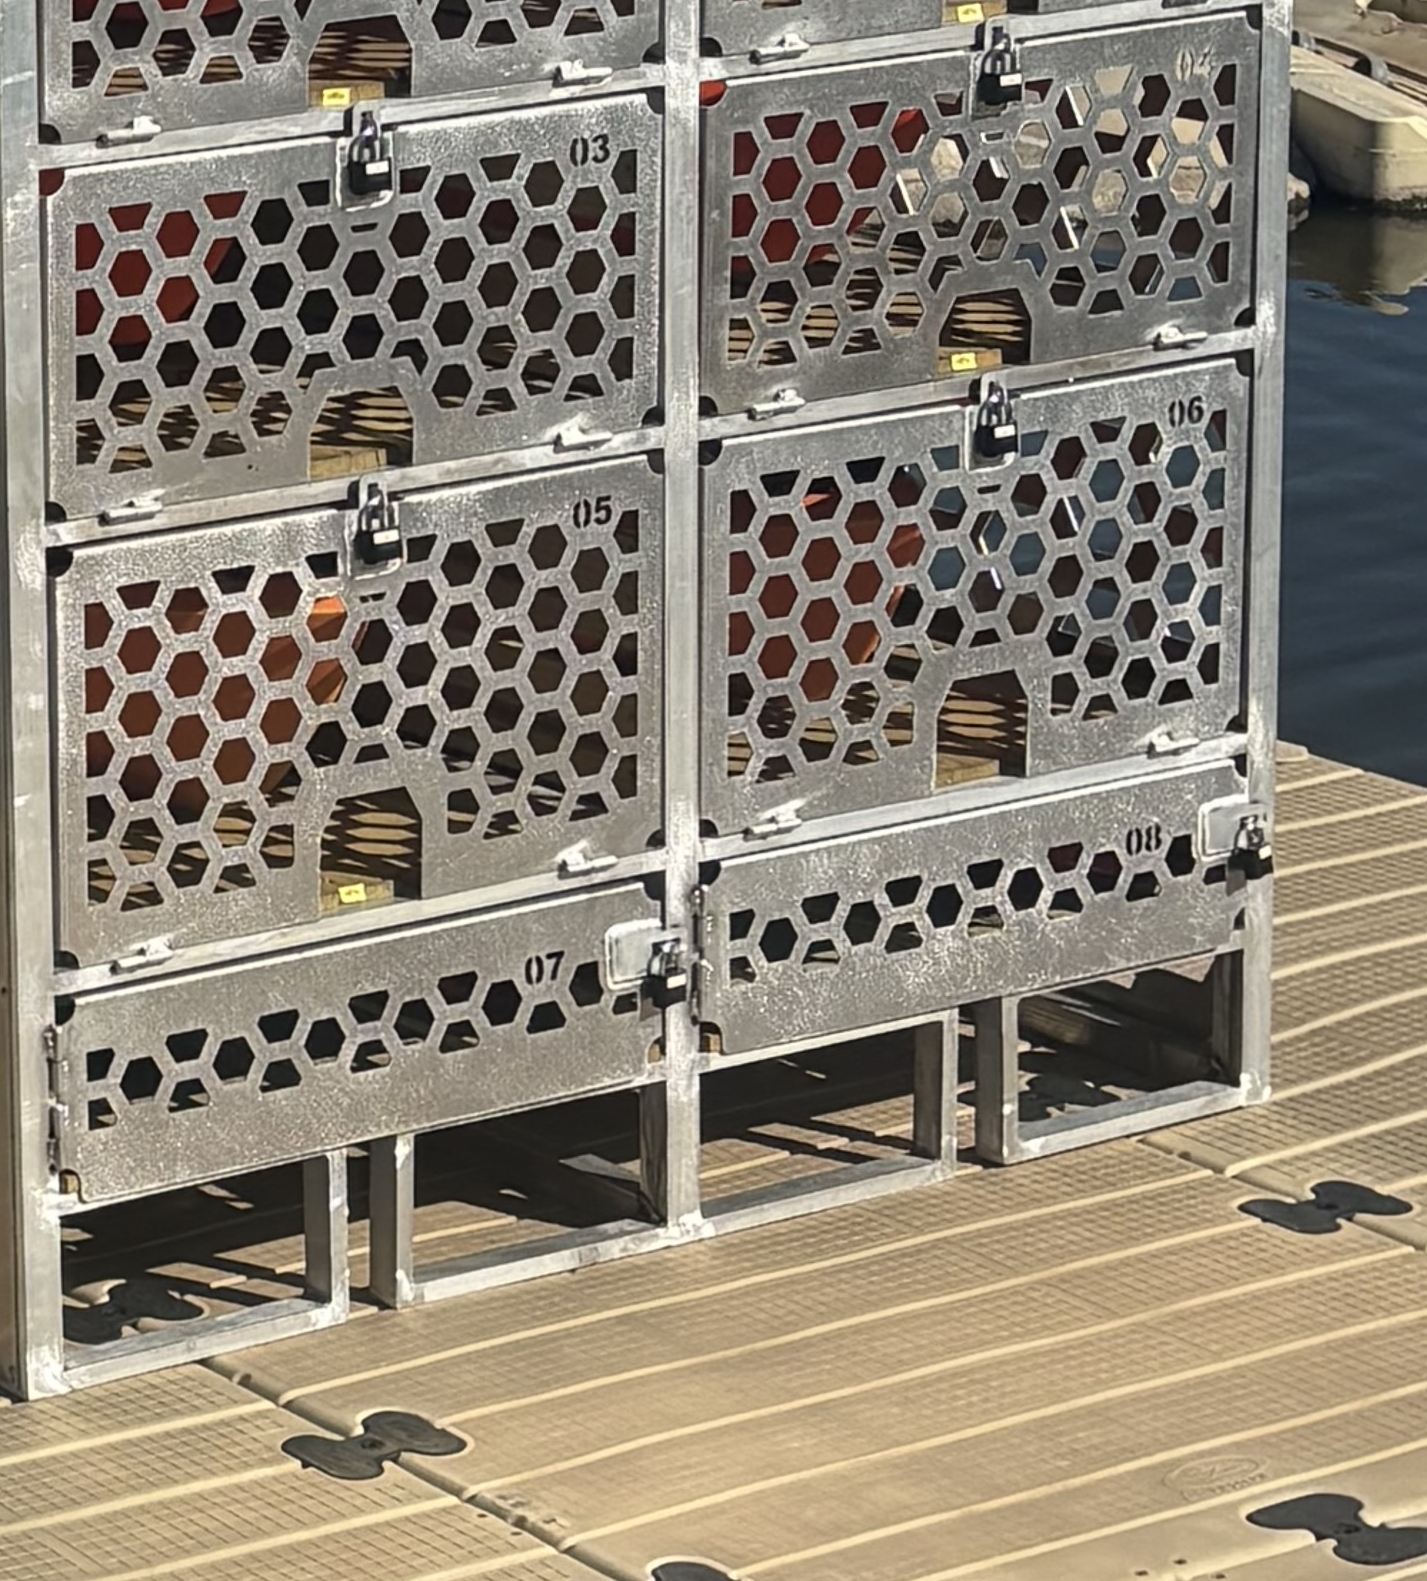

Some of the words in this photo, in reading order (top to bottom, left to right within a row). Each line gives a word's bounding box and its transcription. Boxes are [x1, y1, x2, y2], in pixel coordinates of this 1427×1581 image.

[569, 133, 610, 167] 03
[1168, 394, 1204, 428] 06
[572, 494, 613, 529] 05
[1126, 823, 1162, 856] 08
[524, 950, 565, 985] 07
